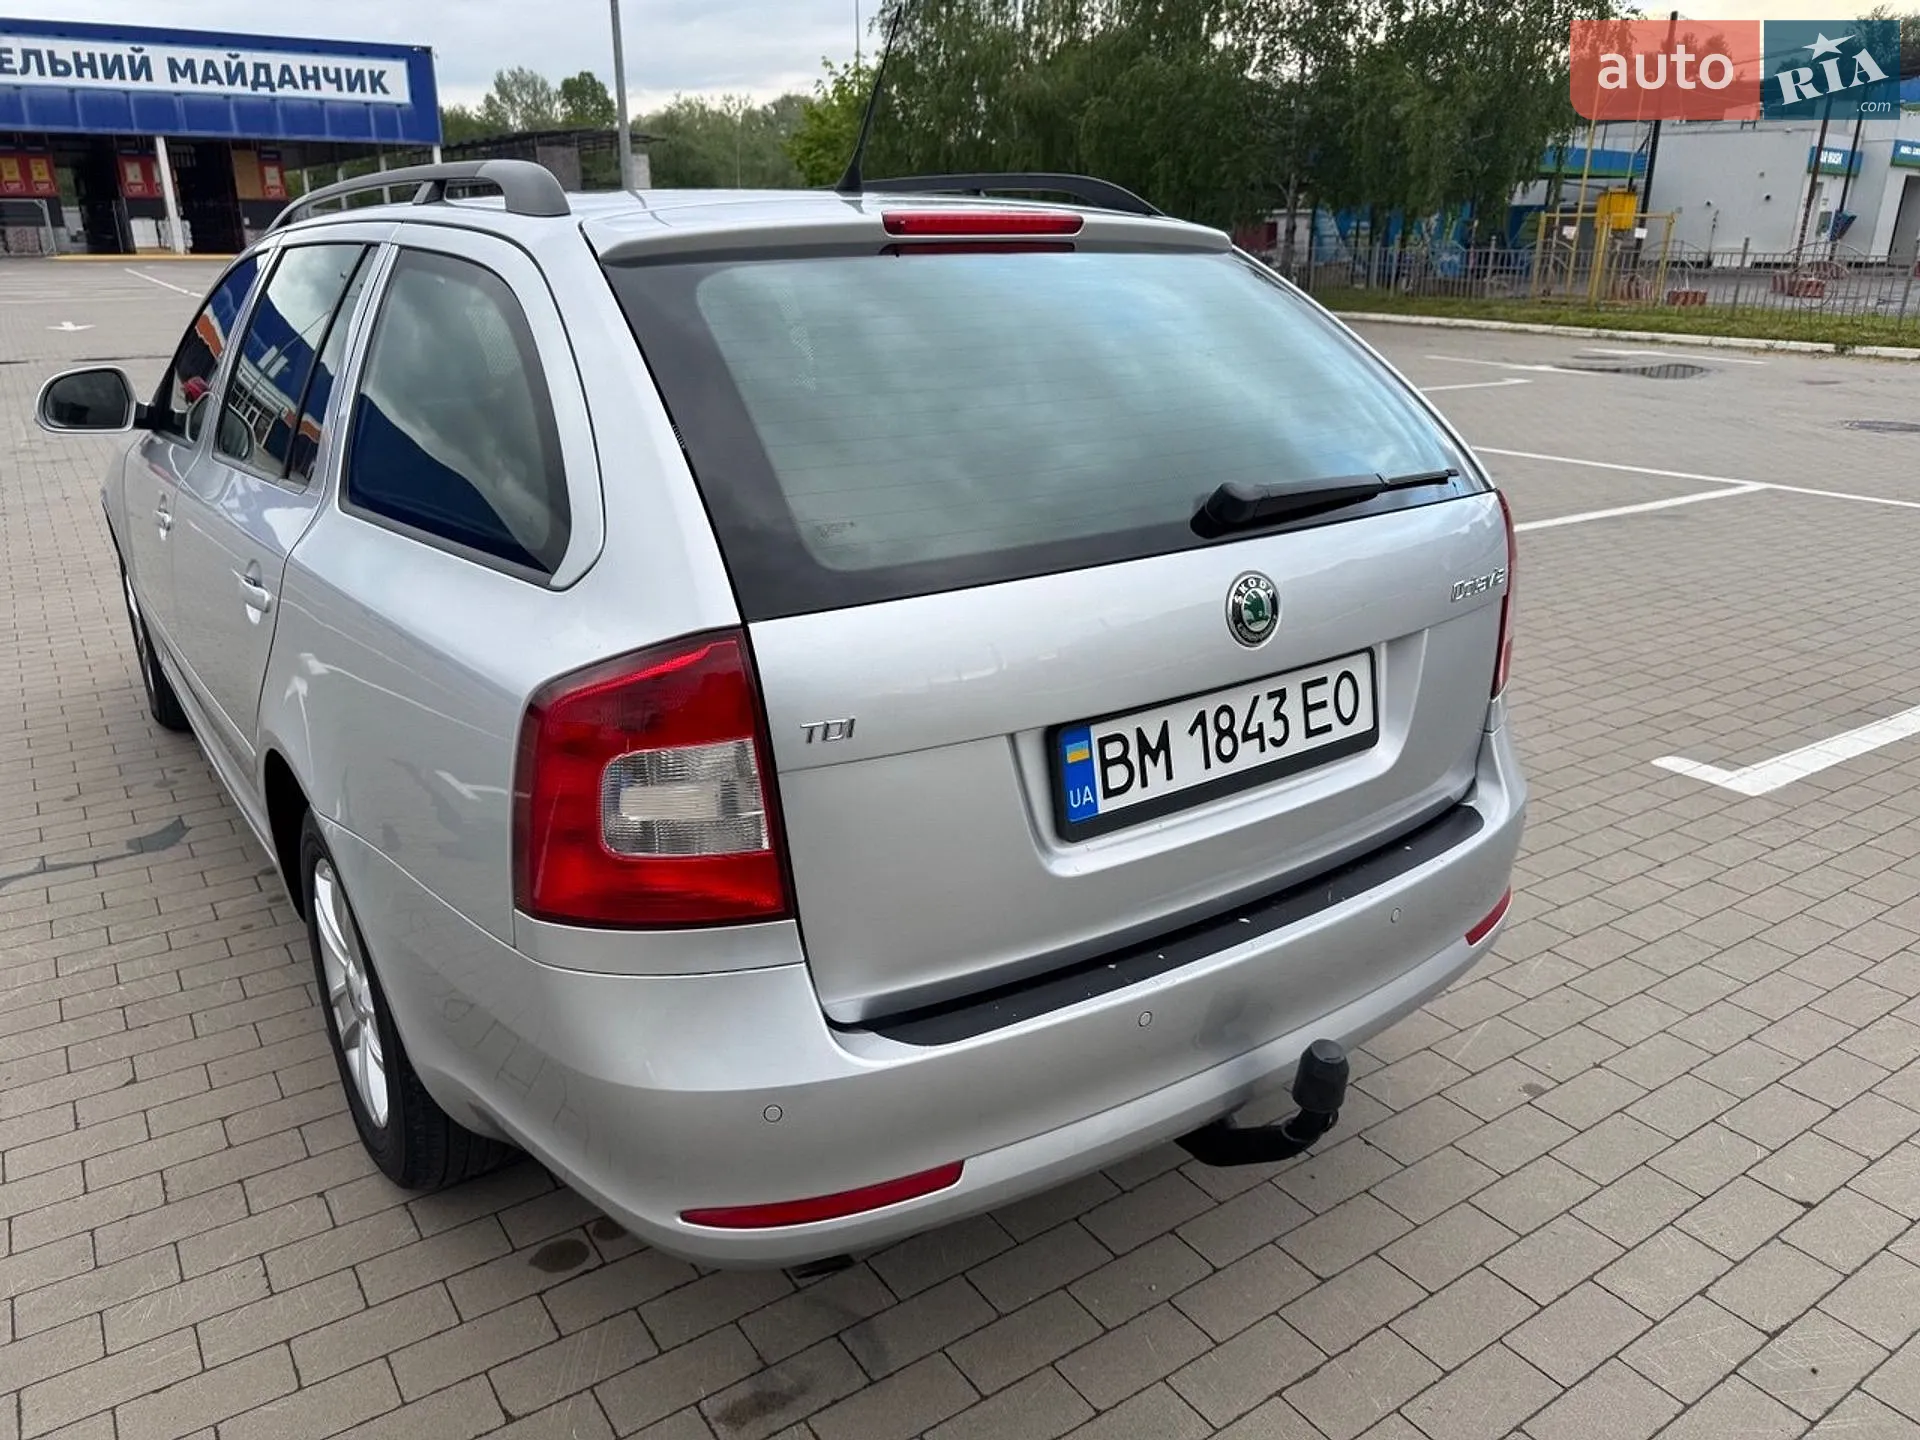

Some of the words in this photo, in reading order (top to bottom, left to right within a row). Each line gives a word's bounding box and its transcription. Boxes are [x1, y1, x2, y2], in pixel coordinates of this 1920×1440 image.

[0, 46, 154, 83] ЕЛЬНИЙ
[166, 53, 391, 96] МАЙДАНЧИК
[799, 715, 857, 745] TDI
[1096, 719, 1175, 800] BM
[1187, 686, 1290, 771] 1843
[1300, 669, 1361, 740] EO
[1069, 786, 1095, 809] UA
